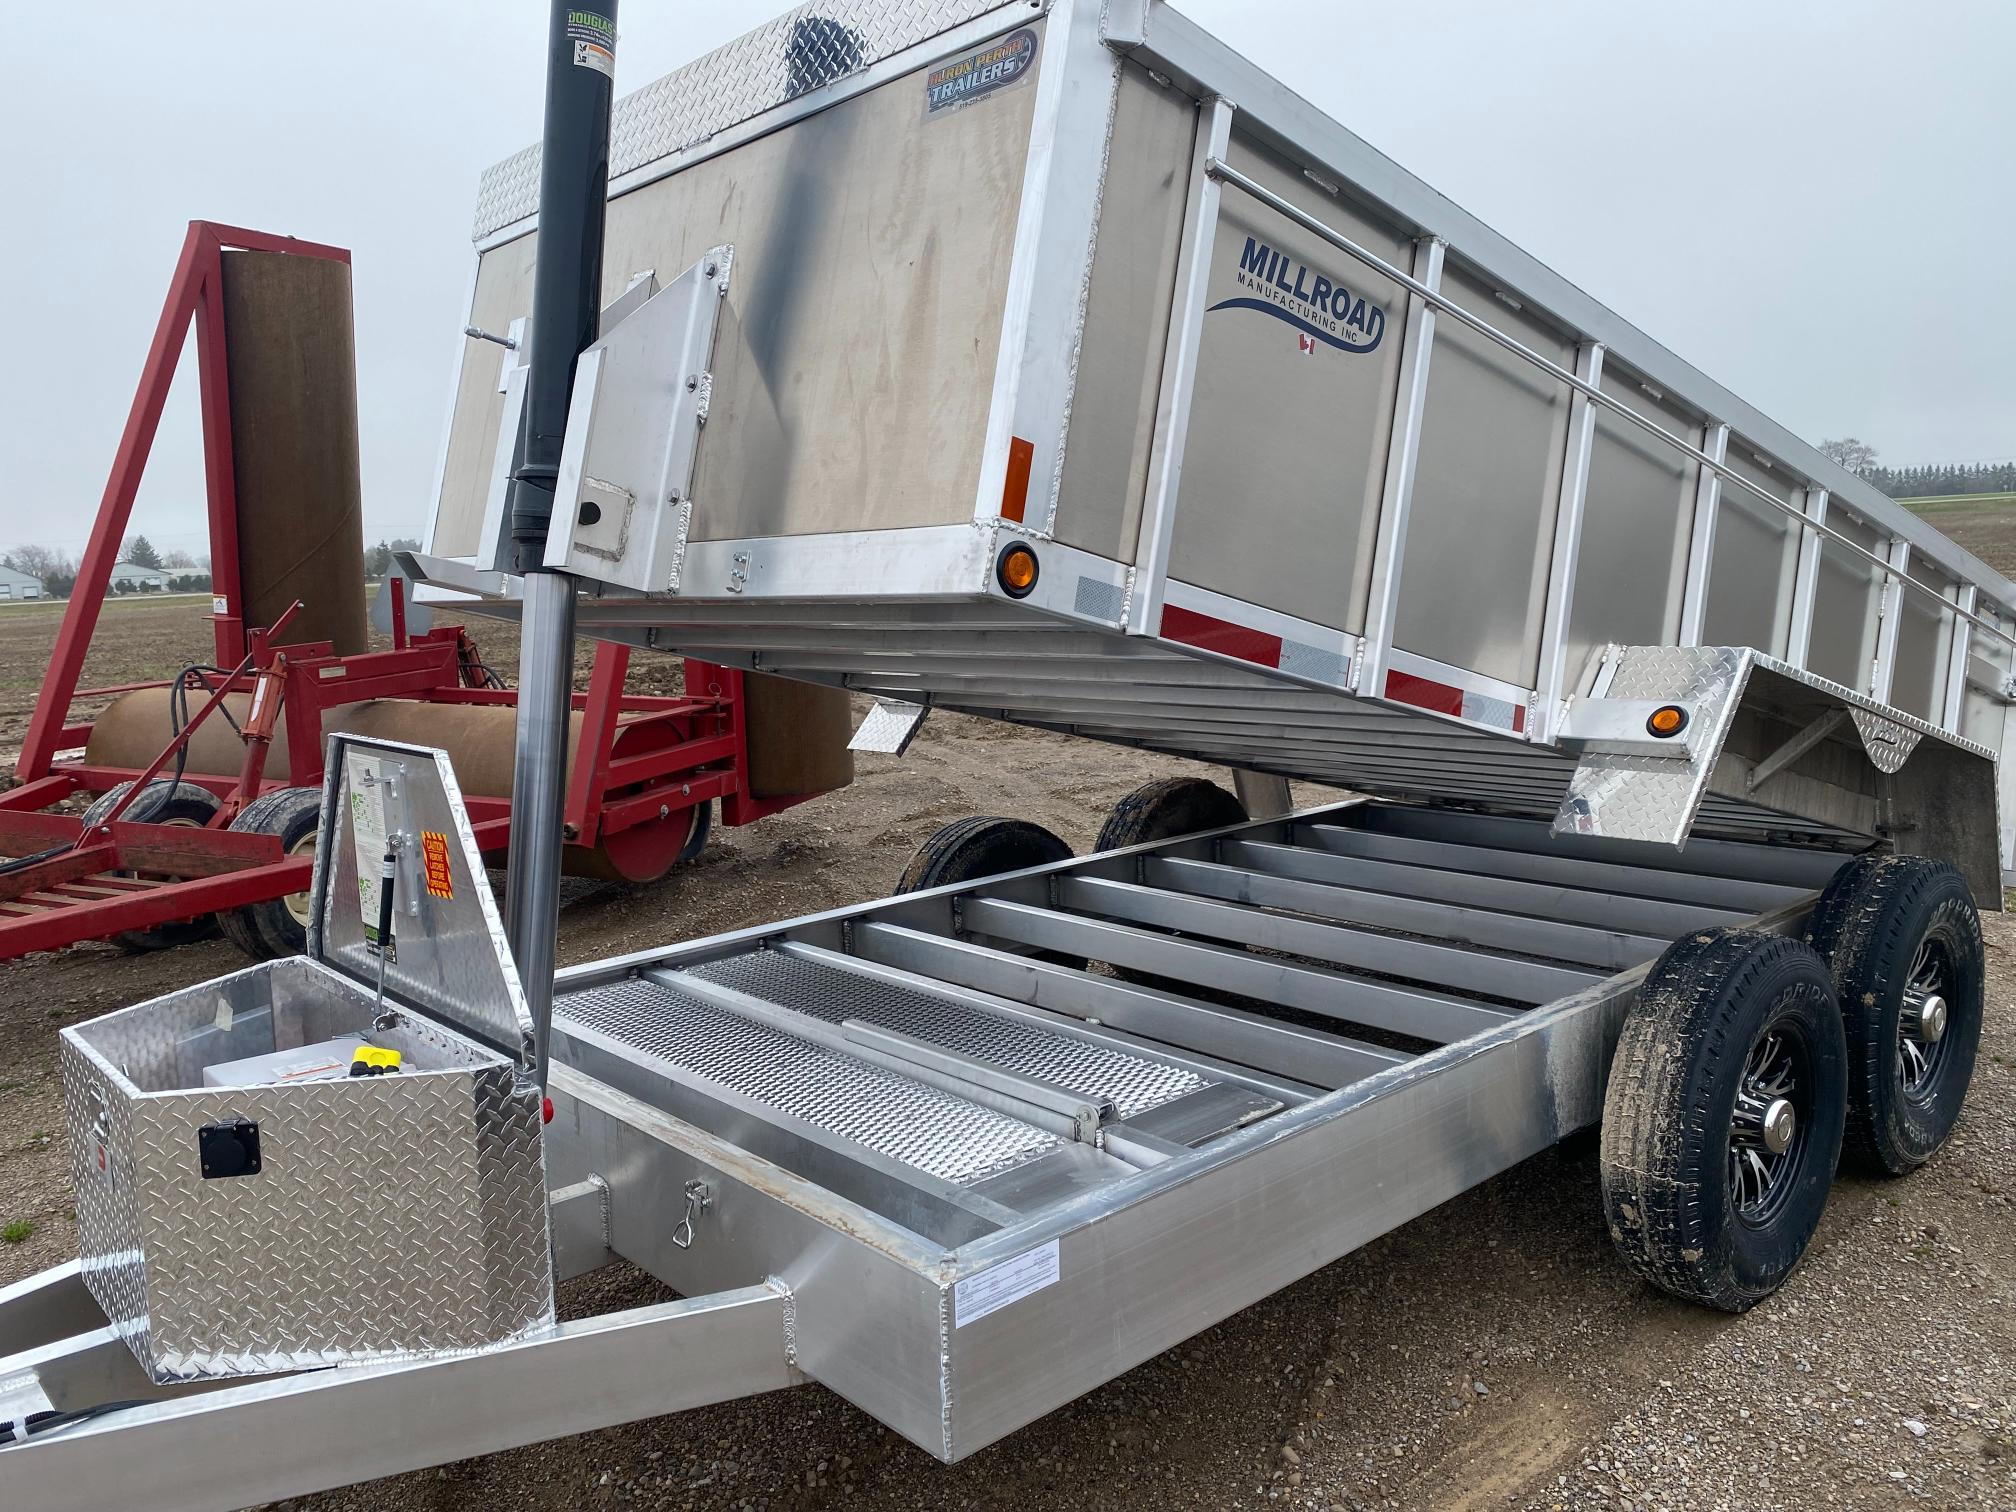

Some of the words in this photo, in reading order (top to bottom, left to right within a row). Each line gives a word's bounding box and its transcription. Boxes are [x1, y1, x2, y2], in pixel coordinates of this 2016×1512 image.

[568, 11, 613, 35] DOUGLAS
[975, 39, 1024, 68] PERTH
[931, 57, 1017, 102] TRAILERS
[1238, 272, 1336, 332] MANUFACTURING
[1341, 326, 1358, 343] INC
[1240, 237, 1385, 337] MILLROAD
